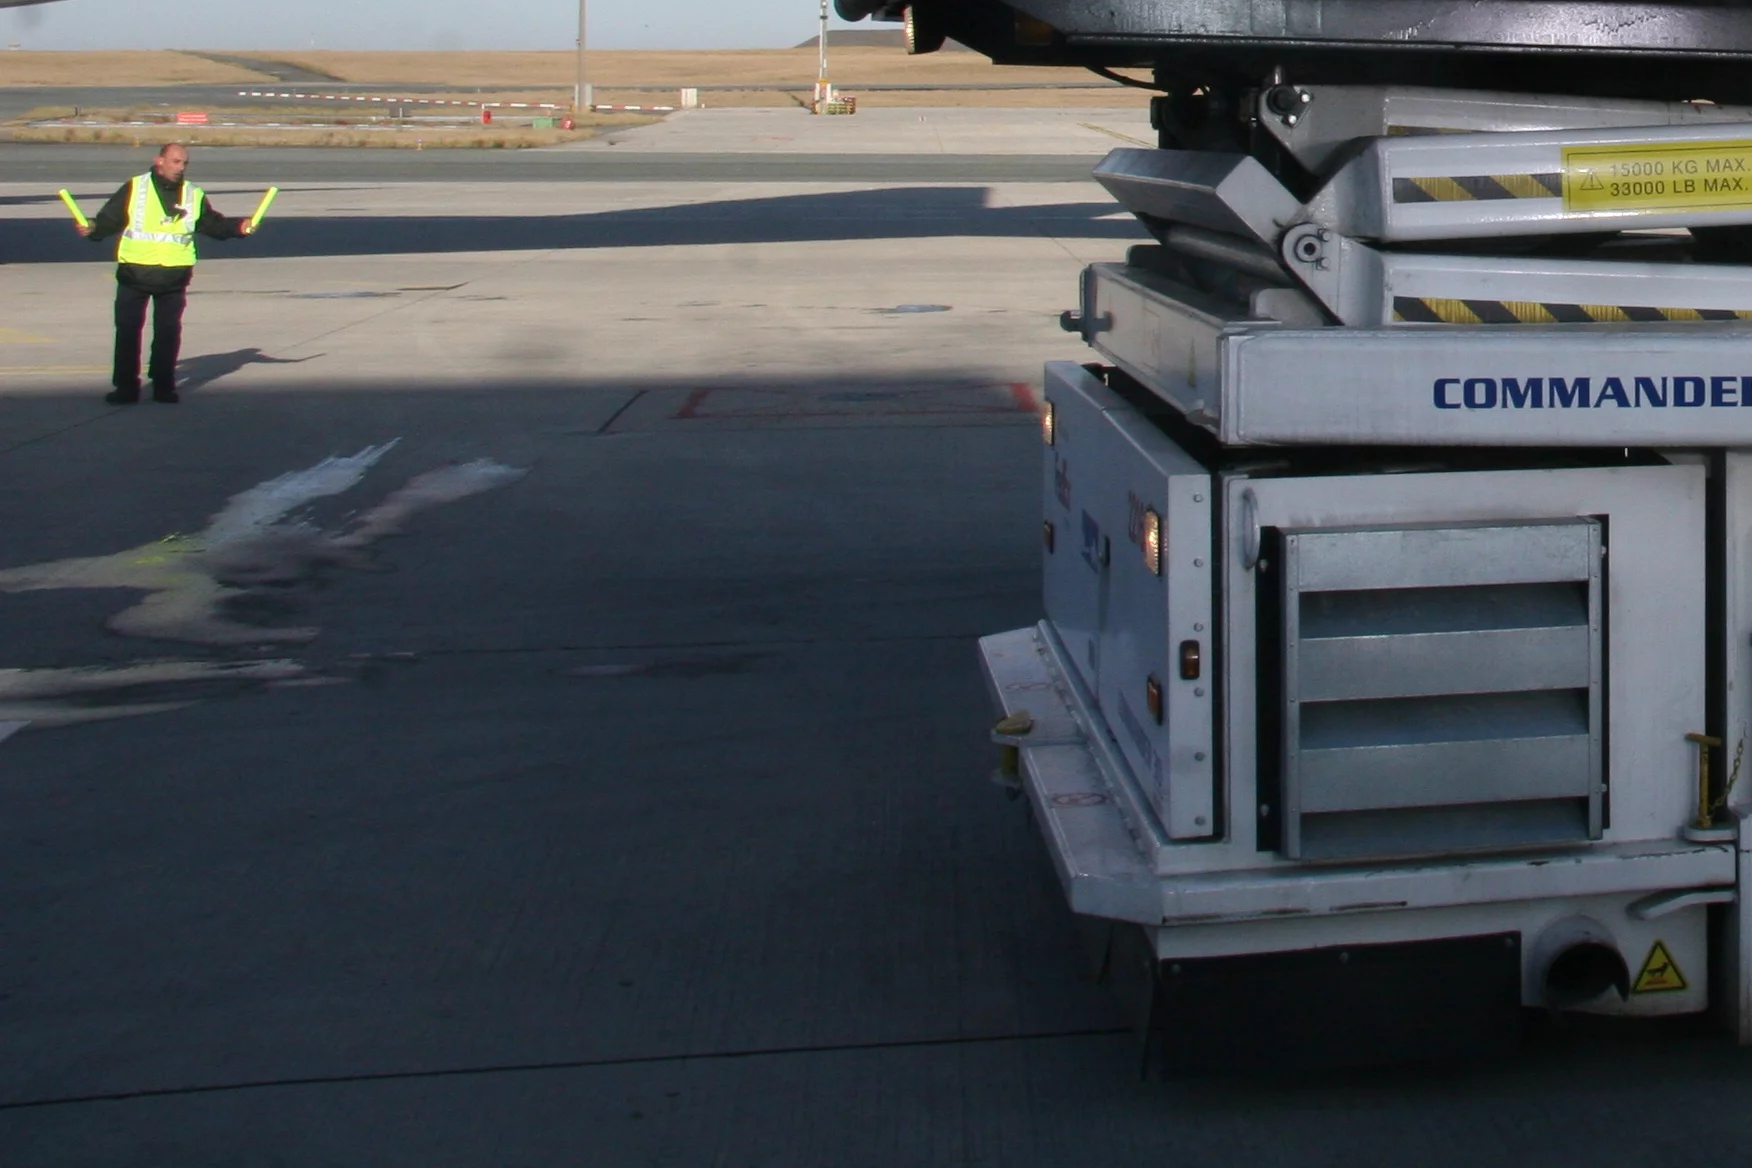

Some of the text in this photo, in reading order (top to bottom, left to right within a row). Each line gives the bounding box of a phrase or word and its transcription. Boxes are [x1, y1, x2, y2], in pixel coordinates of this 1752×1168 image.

[1610, 157, 1752, 178] 15000 KG MAX.
[1610, 176, 1749, 197] 33000 LB MAX.
